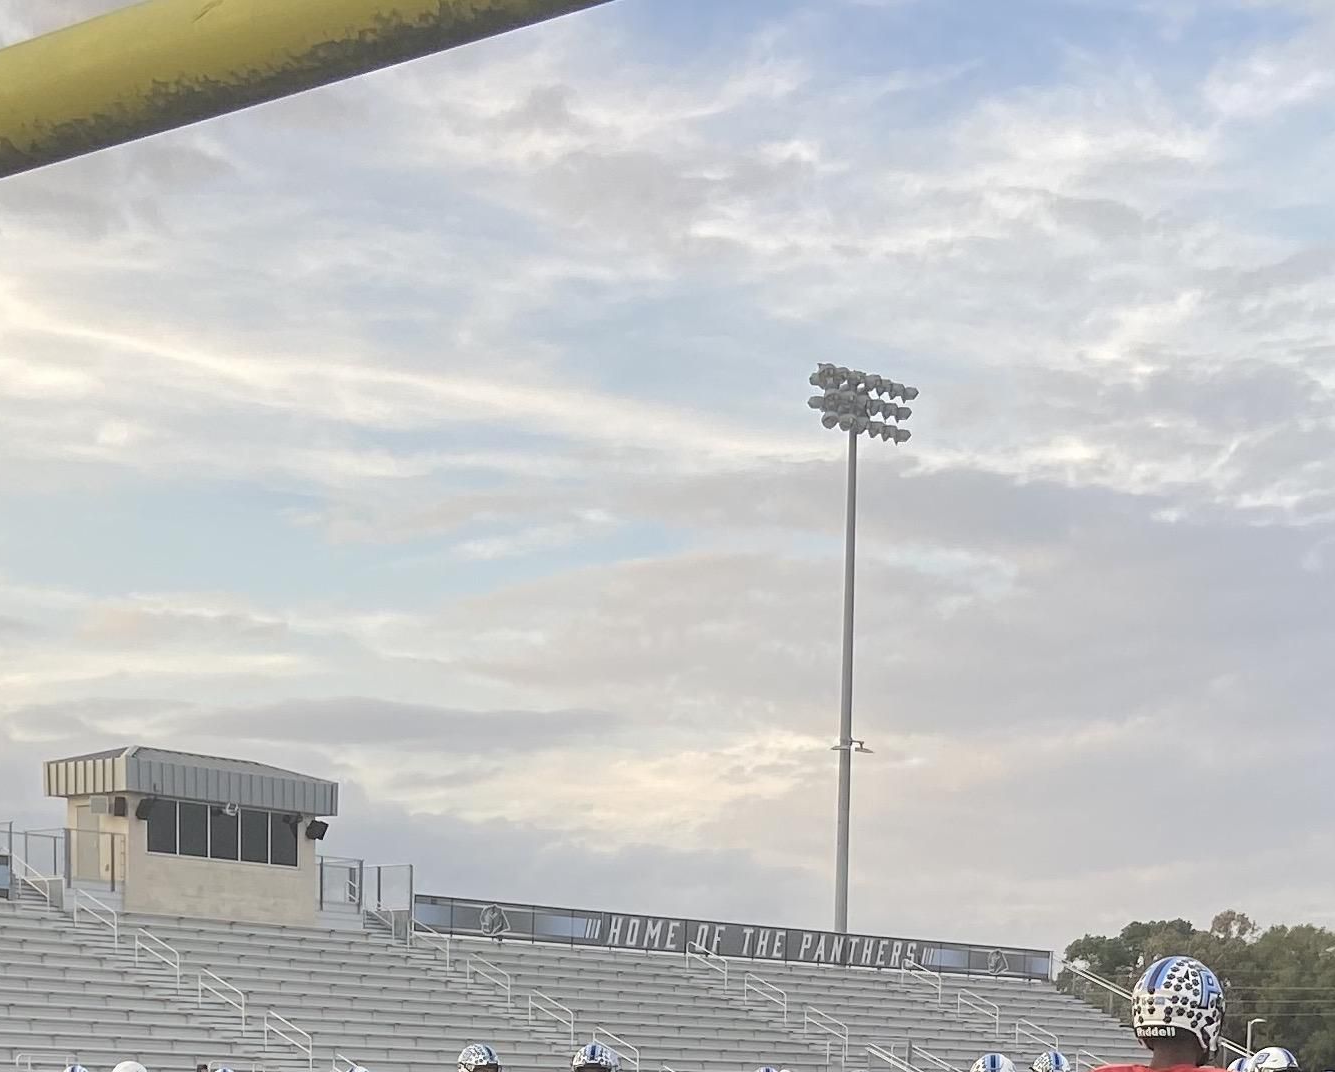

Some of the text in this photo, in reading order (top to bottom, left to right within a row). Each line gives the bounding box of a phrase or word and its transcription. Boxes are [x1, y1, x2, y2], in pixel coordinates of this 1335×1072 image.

[607, 915, 922, 967] HOME OF THE PANTHERS
